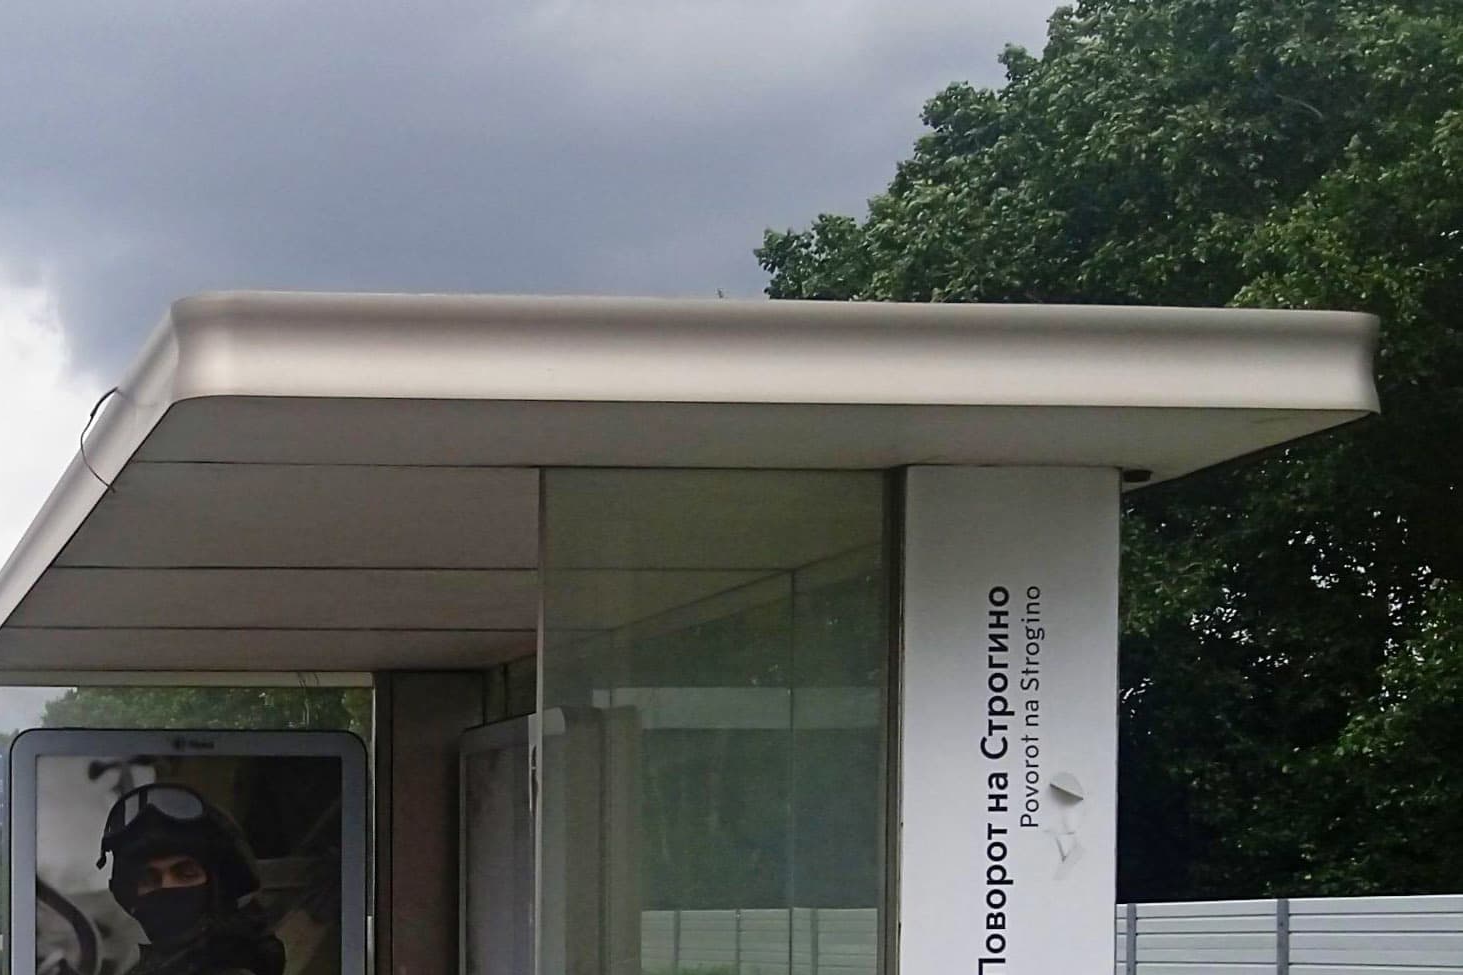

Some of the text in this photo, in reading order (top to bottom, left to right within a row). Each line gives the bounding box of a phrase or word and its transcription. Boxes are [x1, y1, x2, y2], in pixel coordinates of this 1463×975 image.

[980, 585, 1015, 760] Строгино
[1020, 585, 1046, 827] Povorot na Strogino
[987, 772, 1009, 812] на
